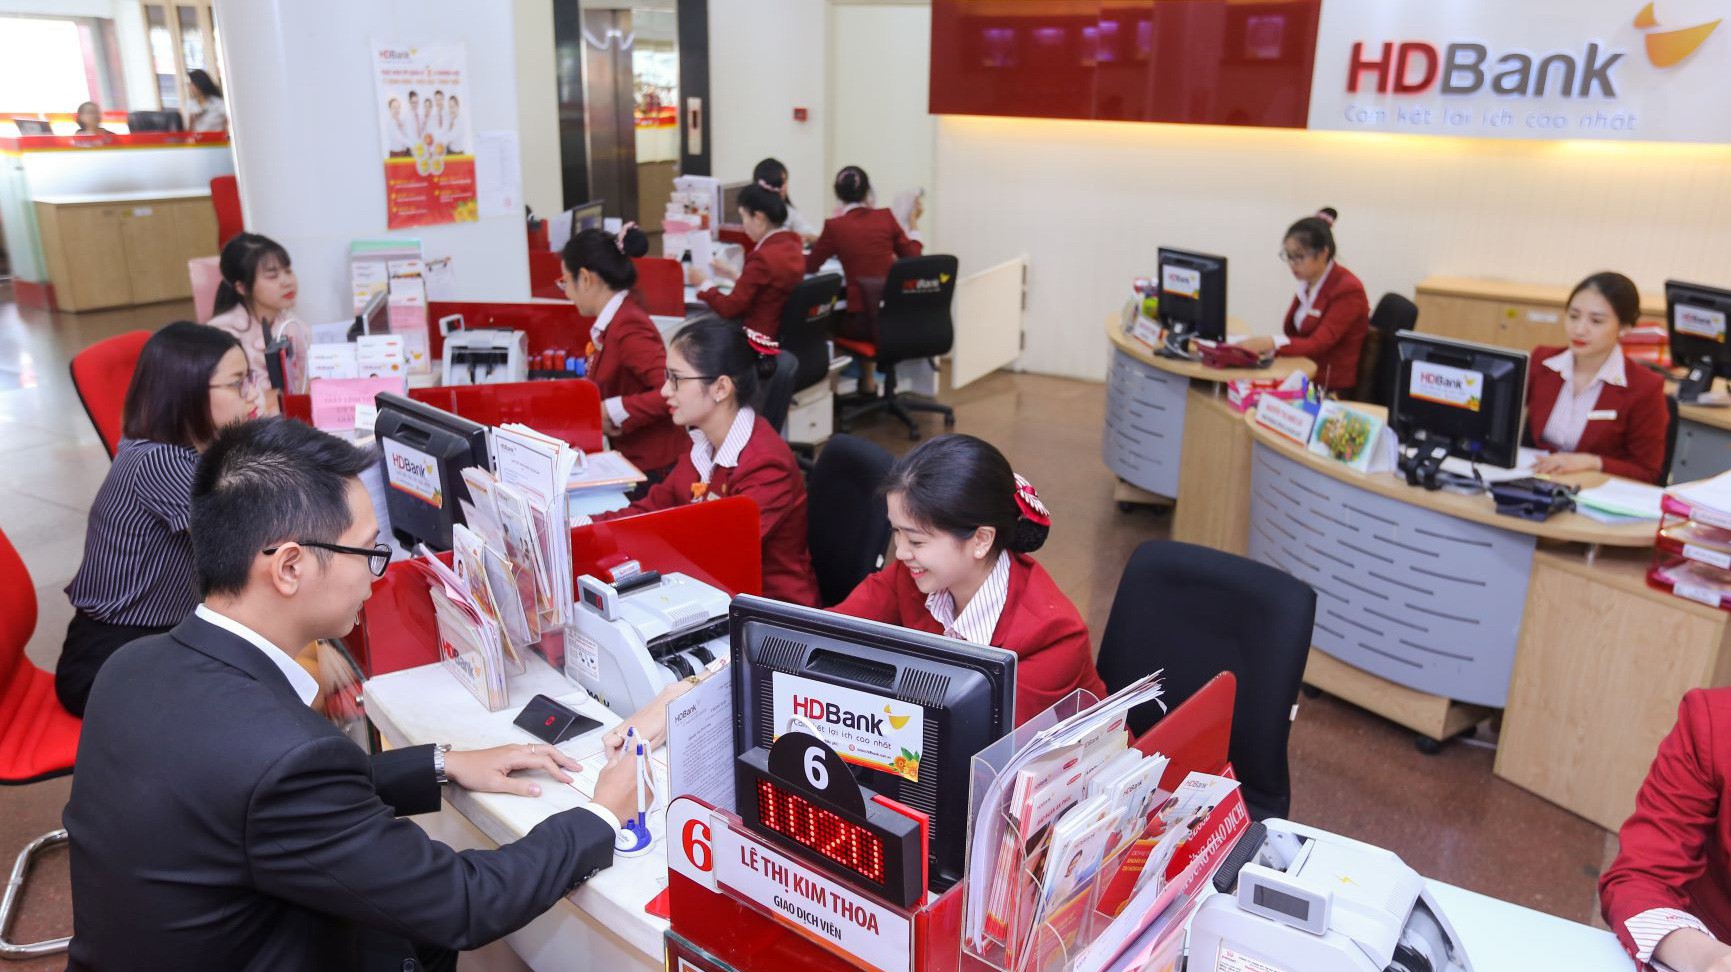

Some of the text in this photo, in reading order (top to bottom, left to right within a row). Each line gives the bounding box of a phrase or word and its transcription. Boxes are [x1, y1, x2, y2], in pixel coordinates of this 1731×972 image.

[1345, 41, 1626, 98] HDBank
[1421, 372, 1462, 389] HDBank
[392, 452, 425, 478] HDBank
[793, 694, 884, 737] HDBank
[856, 736, 870, 744] cao
[803, 746, 829, 791] 6
[1224, 801, 1245, 831] DỊCH
[682, 818, 713, 872] 6
[740, 845, 880, 936] LÊ THỊ KIM THOA
[773, 895, 842, 940] GIAO DỊCH VIÊN
